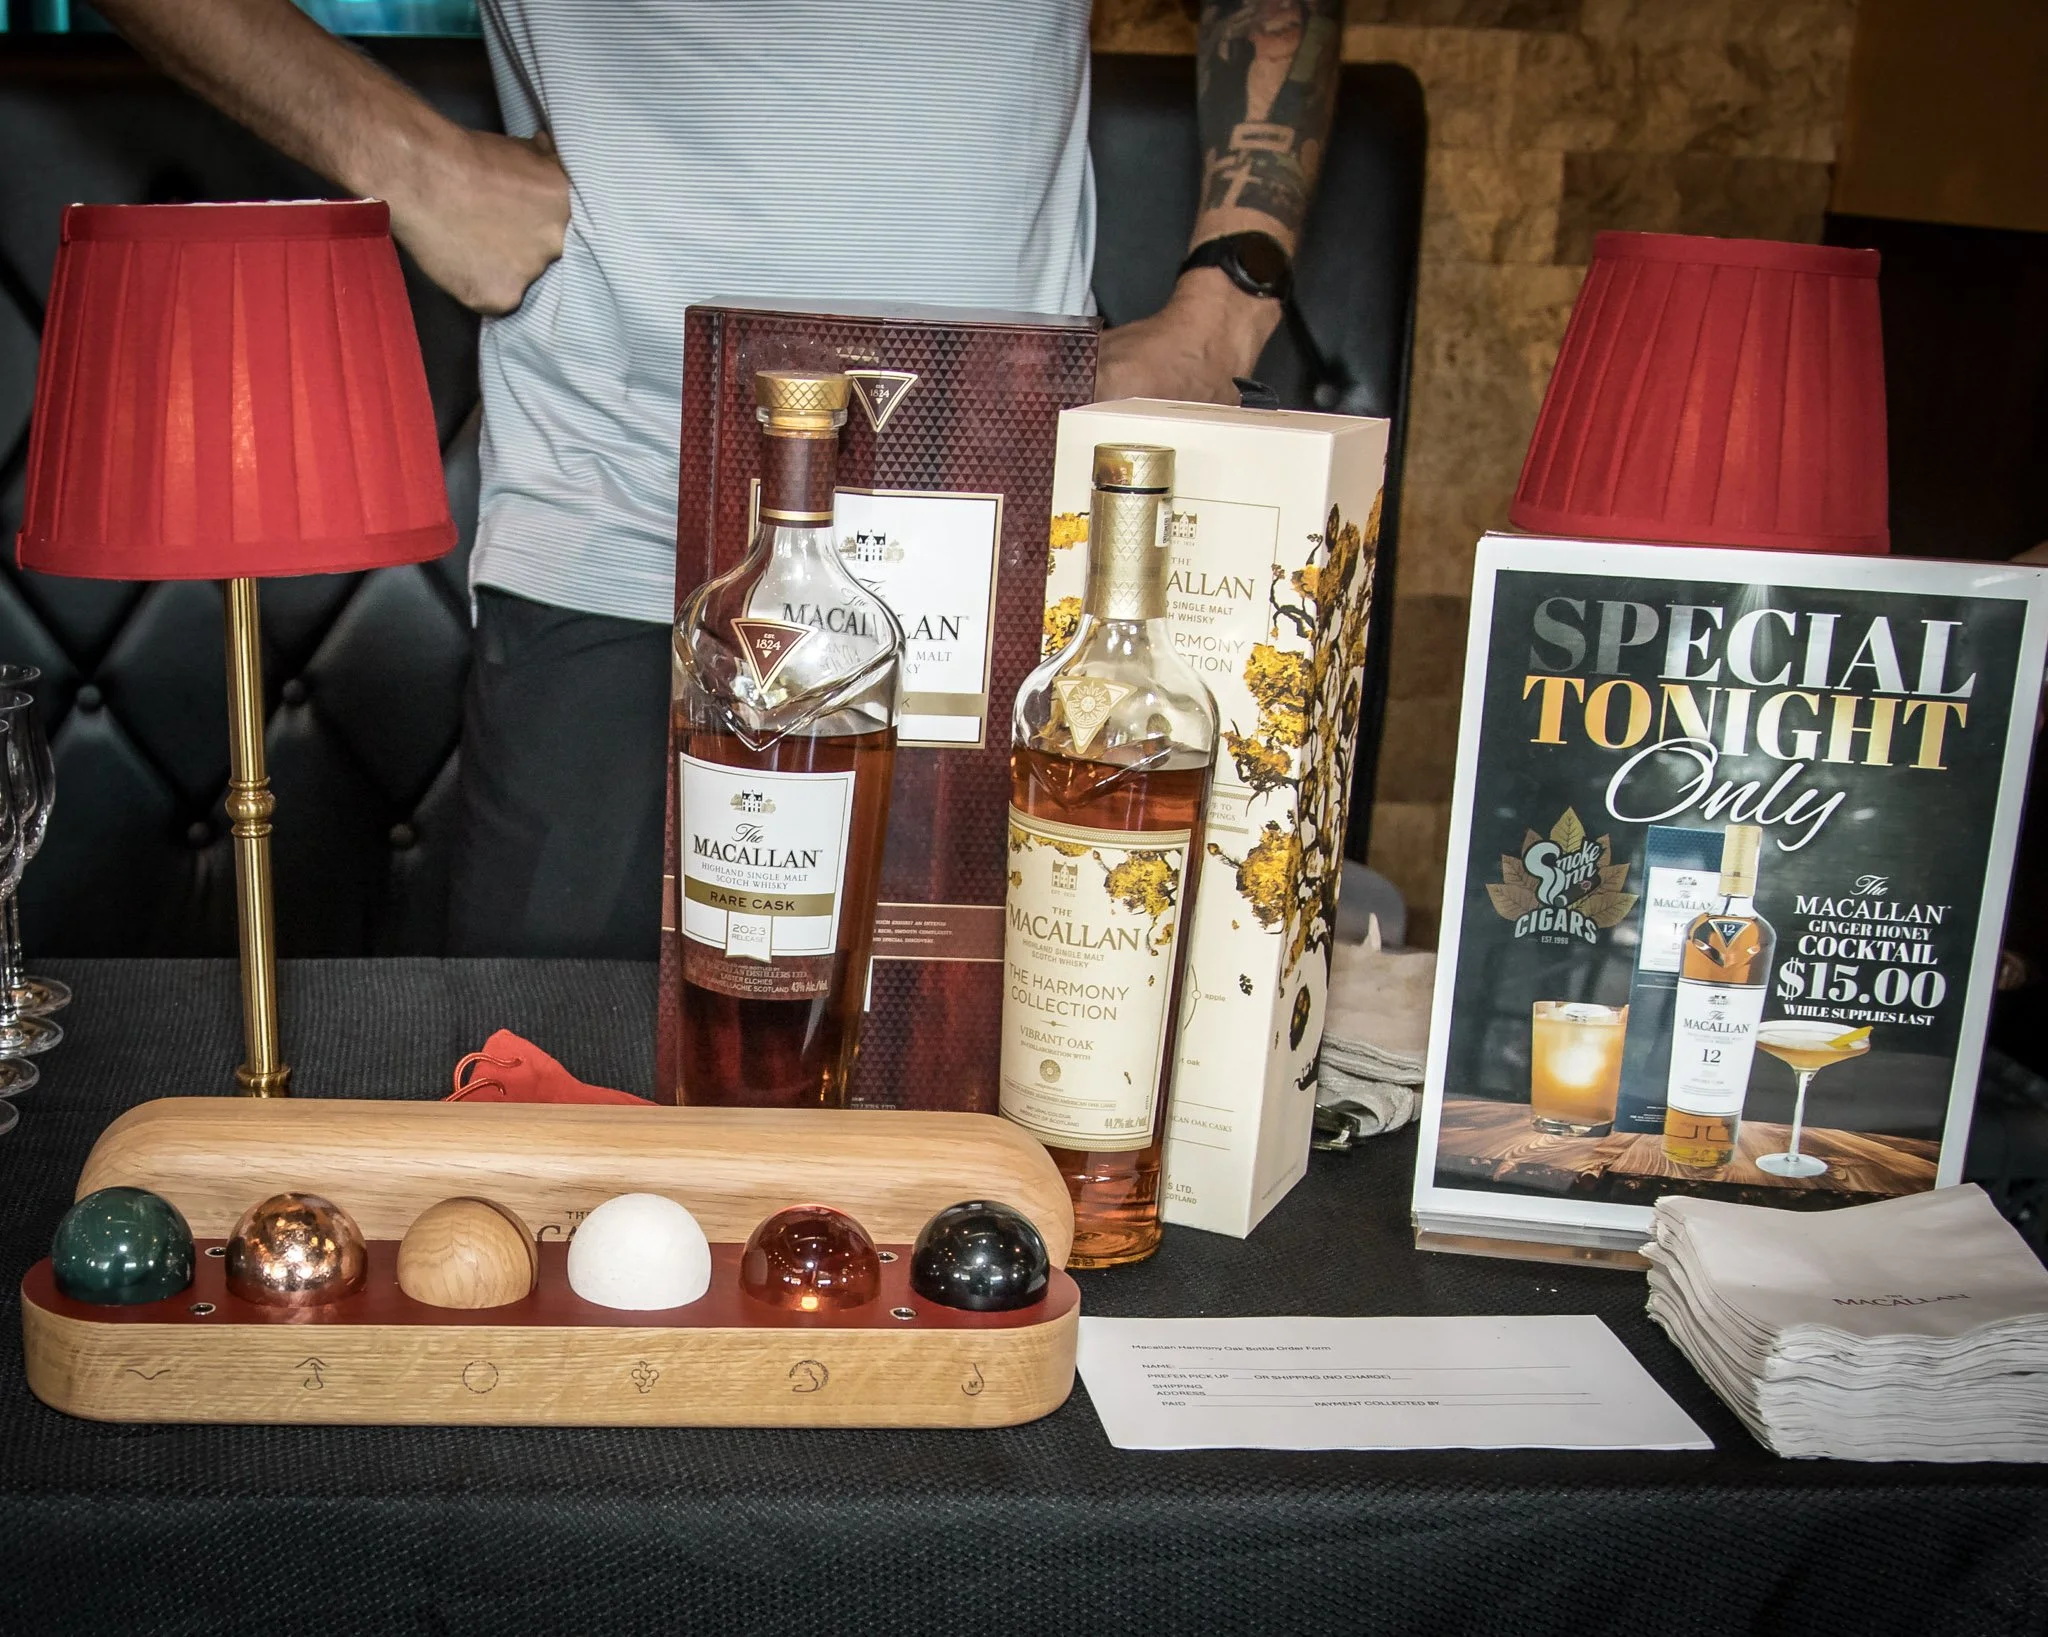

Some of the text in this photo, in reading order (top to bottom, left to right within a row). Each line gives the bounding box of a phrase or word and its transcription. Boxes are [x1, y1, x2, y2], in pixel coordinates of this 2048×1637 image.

[870, 389, 890, 398] 1824
[1171, 556, 1192, 566] THE
[1166, 570, 1255, 601] ALLAN
[1173, 601, 1206, 612] SINGLE
[1209, 604, 1234, 616] MALT
[1178, 613, 1215, 624] WHISKY
[755, 638, 782, 651] 1824
[1174, 632, 1245, 655] RMONY
[1527, 595, 1977, 699] SPECIAL
[916, 652, 952, 663] MALT
[1522, 674, 1968, 771] TONIGHT
[1604, 737, 1847, 853] Only
[731, 822, 765, 844] The
[693, 834, 819, 869] MACALLAN
[701, 861, 809, 882] HIGHLAND SINGLE MALT
[716, 874, 789, 890] SCOTCH WHISKY
[1850, 874, 1889, 896] The
[710, 890, 796, 912] RARE CASK
[1794, 895, 1944, 924] MACALLAN
[1051, 906, 1073, 918] THE
[732, 923, 767, 936] 2023
[1008, 903, 1141, 951] MACALLAN
[1514, 907, 1597, 945] CIGARS
[1722, 924, 1735, 934] 12
[1808, 919, 1933, 941] GINGER HONEY
[731, 934, 765, 943] RELEASE
[1055, 947, 1081, 960] SINGLE
[1083, 952, 1105, 962] MALT
[1798, 934, 1939, 965] COCKTAIL
[1031, 950, 1089, 968] SCOTCH WHISKY
[744, 977, 774, 986] ELCHIES
[1008, 962, 1131, 1002] THE HARMONY
[1776, 956, 1947, 1009] $15.00
[1010, 984, 1119, 1022] COLLECTION
[1204, 992, 1226, 1002] apple
[1784, 1004, 1936, 1026] WHILE SUPPLIES LAST
[1683, 1017, 1751, 1034] MACALLAN
[1019, 1024, 1095, 1051] VIBRANT OAK
[1700, 1048, 1721, 1064] 12
[1191, 1118, 1207, 1128] OAK
[1208, 1122, 1233, 1133] CASKS
[1176, 1183, 1194, 1195] LTD.
[1832, 1293, 1973, 1307] MACALLAN
[1178, 1344, 1222, 1352] Harmony
